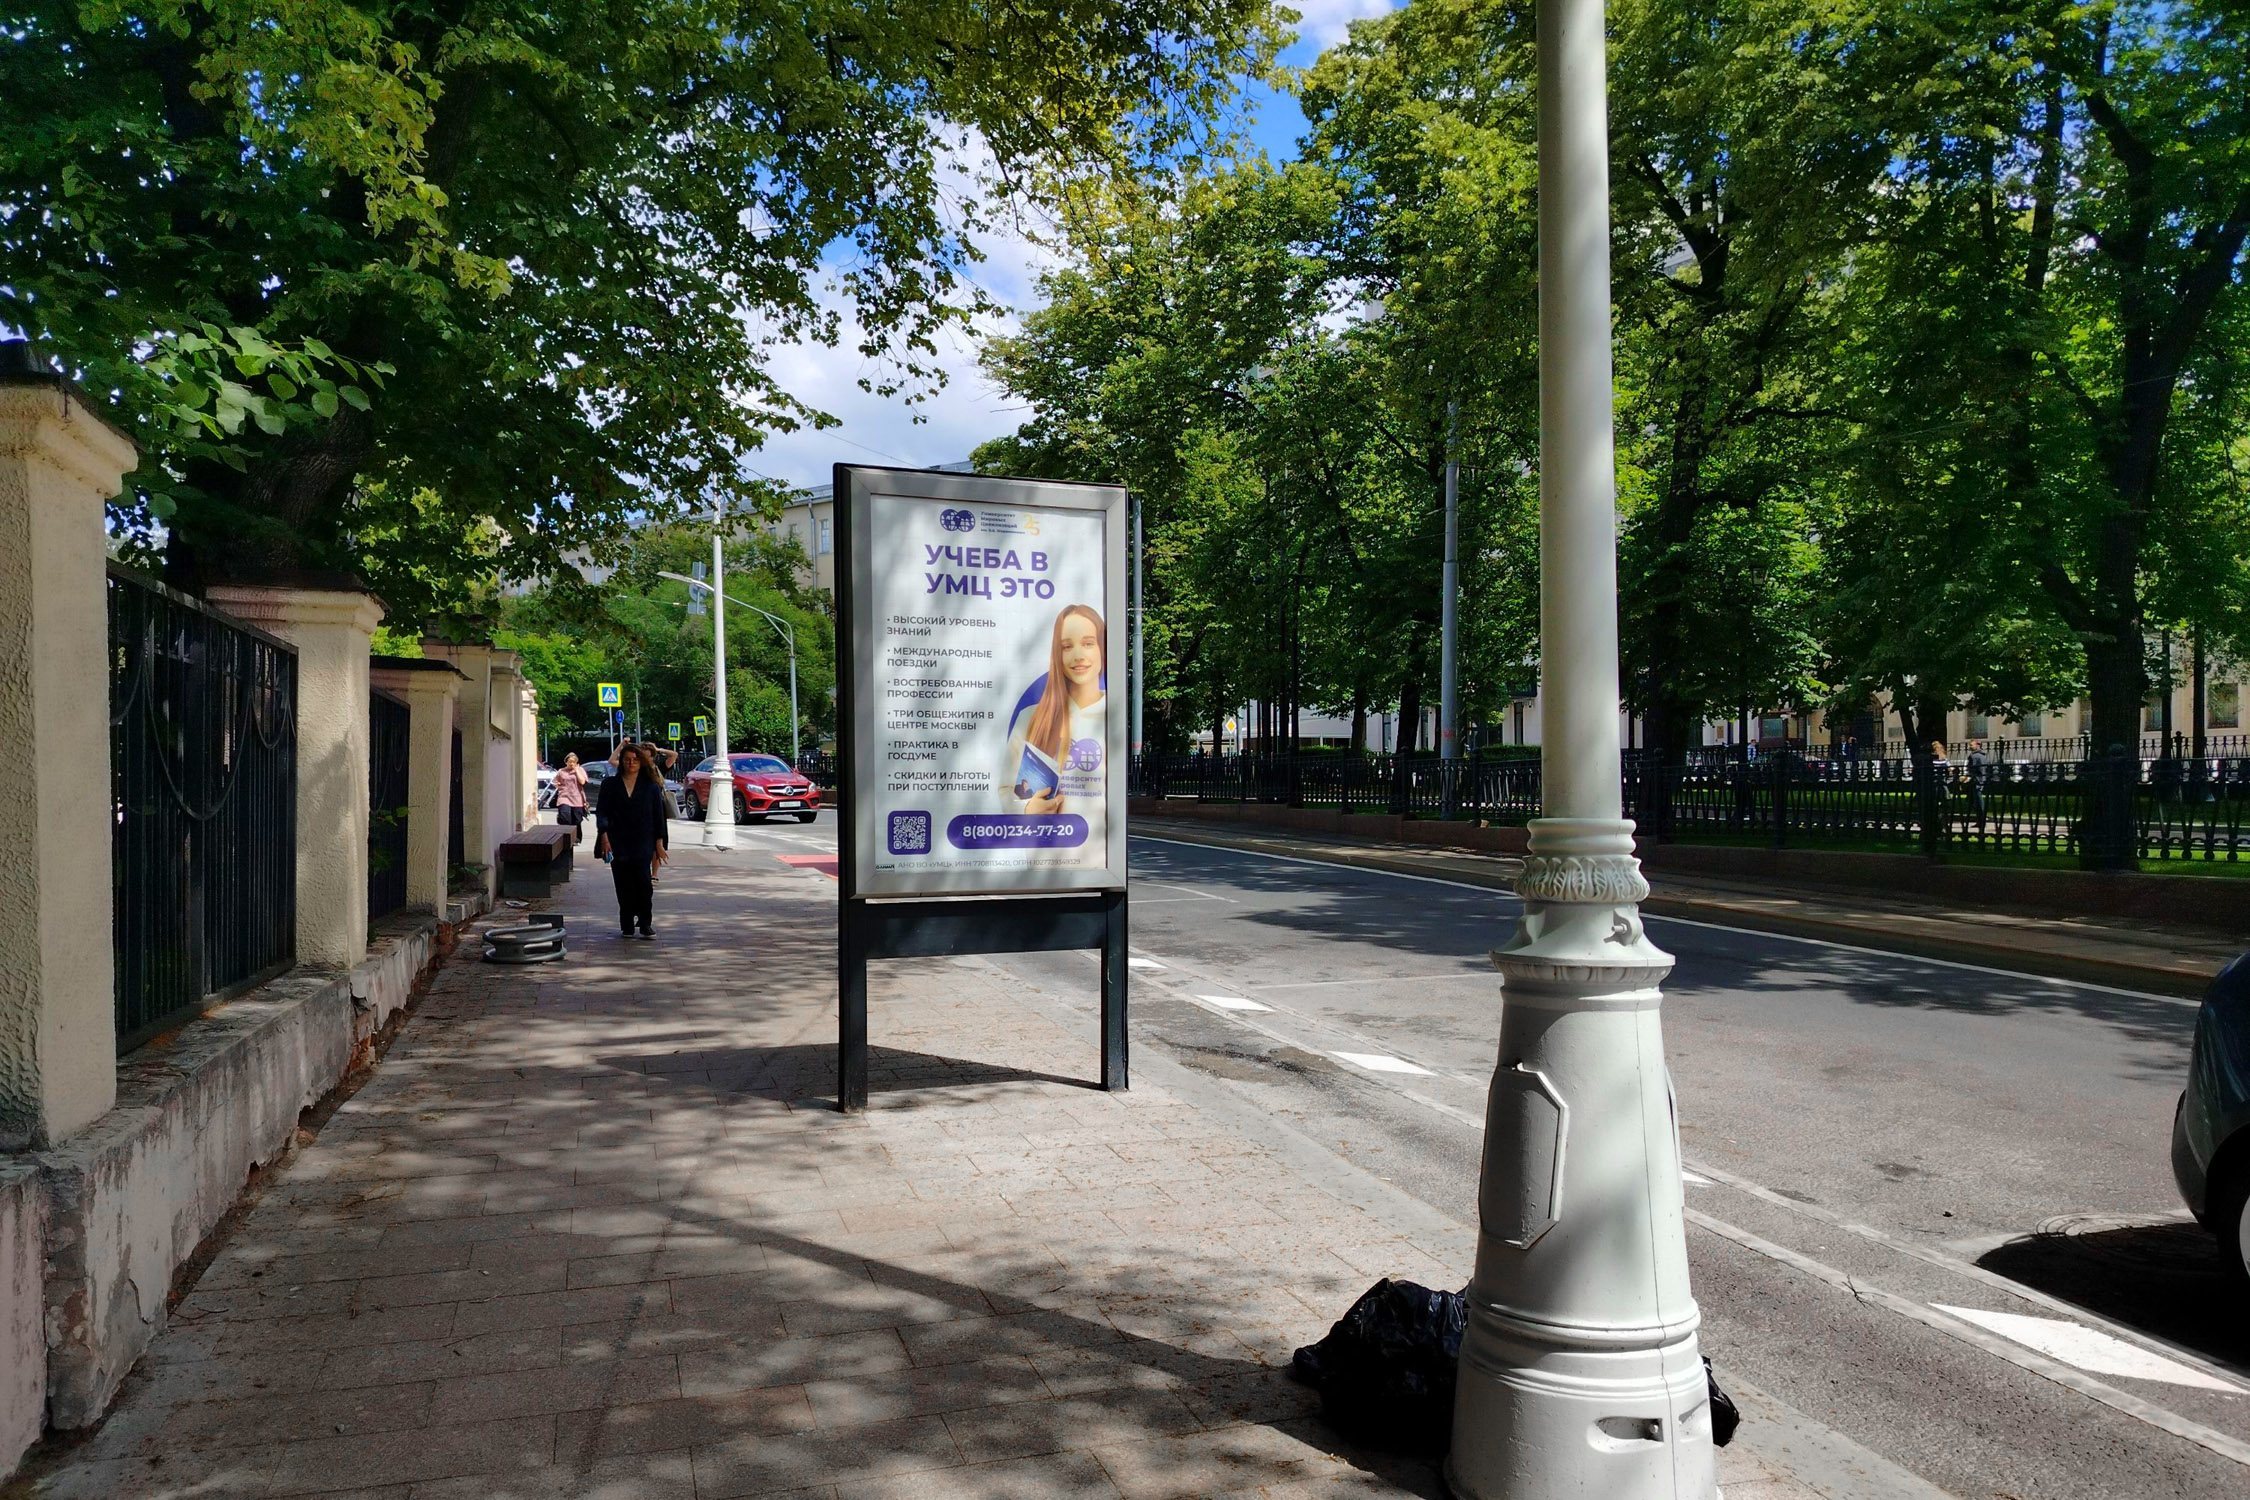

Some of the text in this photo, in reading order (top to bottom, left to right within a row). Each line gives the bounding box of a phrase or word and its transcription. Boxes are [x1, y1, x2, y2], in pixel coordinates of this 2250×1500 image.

[925, 544, 1048, 571] УЧЕБА В
[925, 573, 1055, 600] УМЦ ЭТО
[893, 616, 996, 627] ВЫСОКИЙ УРОВЕНЬ
[887, 626, 931, 636] ЗНАНИЙ
[893, 647, 992, 658] МЕЖДУНАРОДНЫЕ
[887, 658, 937, 668] ПОЕЗДКИ
[893, 678, 993, 688] ВОСТРЕБОВАННЫЕ
[887, 689, 953, 699] ПРОФЕССИИ
[893, 710, 994, 719] ТРИ ОБЩЕЖИТИЯ В
[887, 721, 977, 730] ЦЕНТРЕ МОСКВЫ
[894, 741, 959, 749] ПРАКТИКА В
[888, 752, 937, 761] ГОСДУМЕ
[894, 772, 991, 780] СКИДКИ И ЛЬГОТЫ
[888, 783, 989, 791] ПРИ ПОСТУПЛЕНИИ
[962, 825, 1074, 839] 8(800)234-77-20
